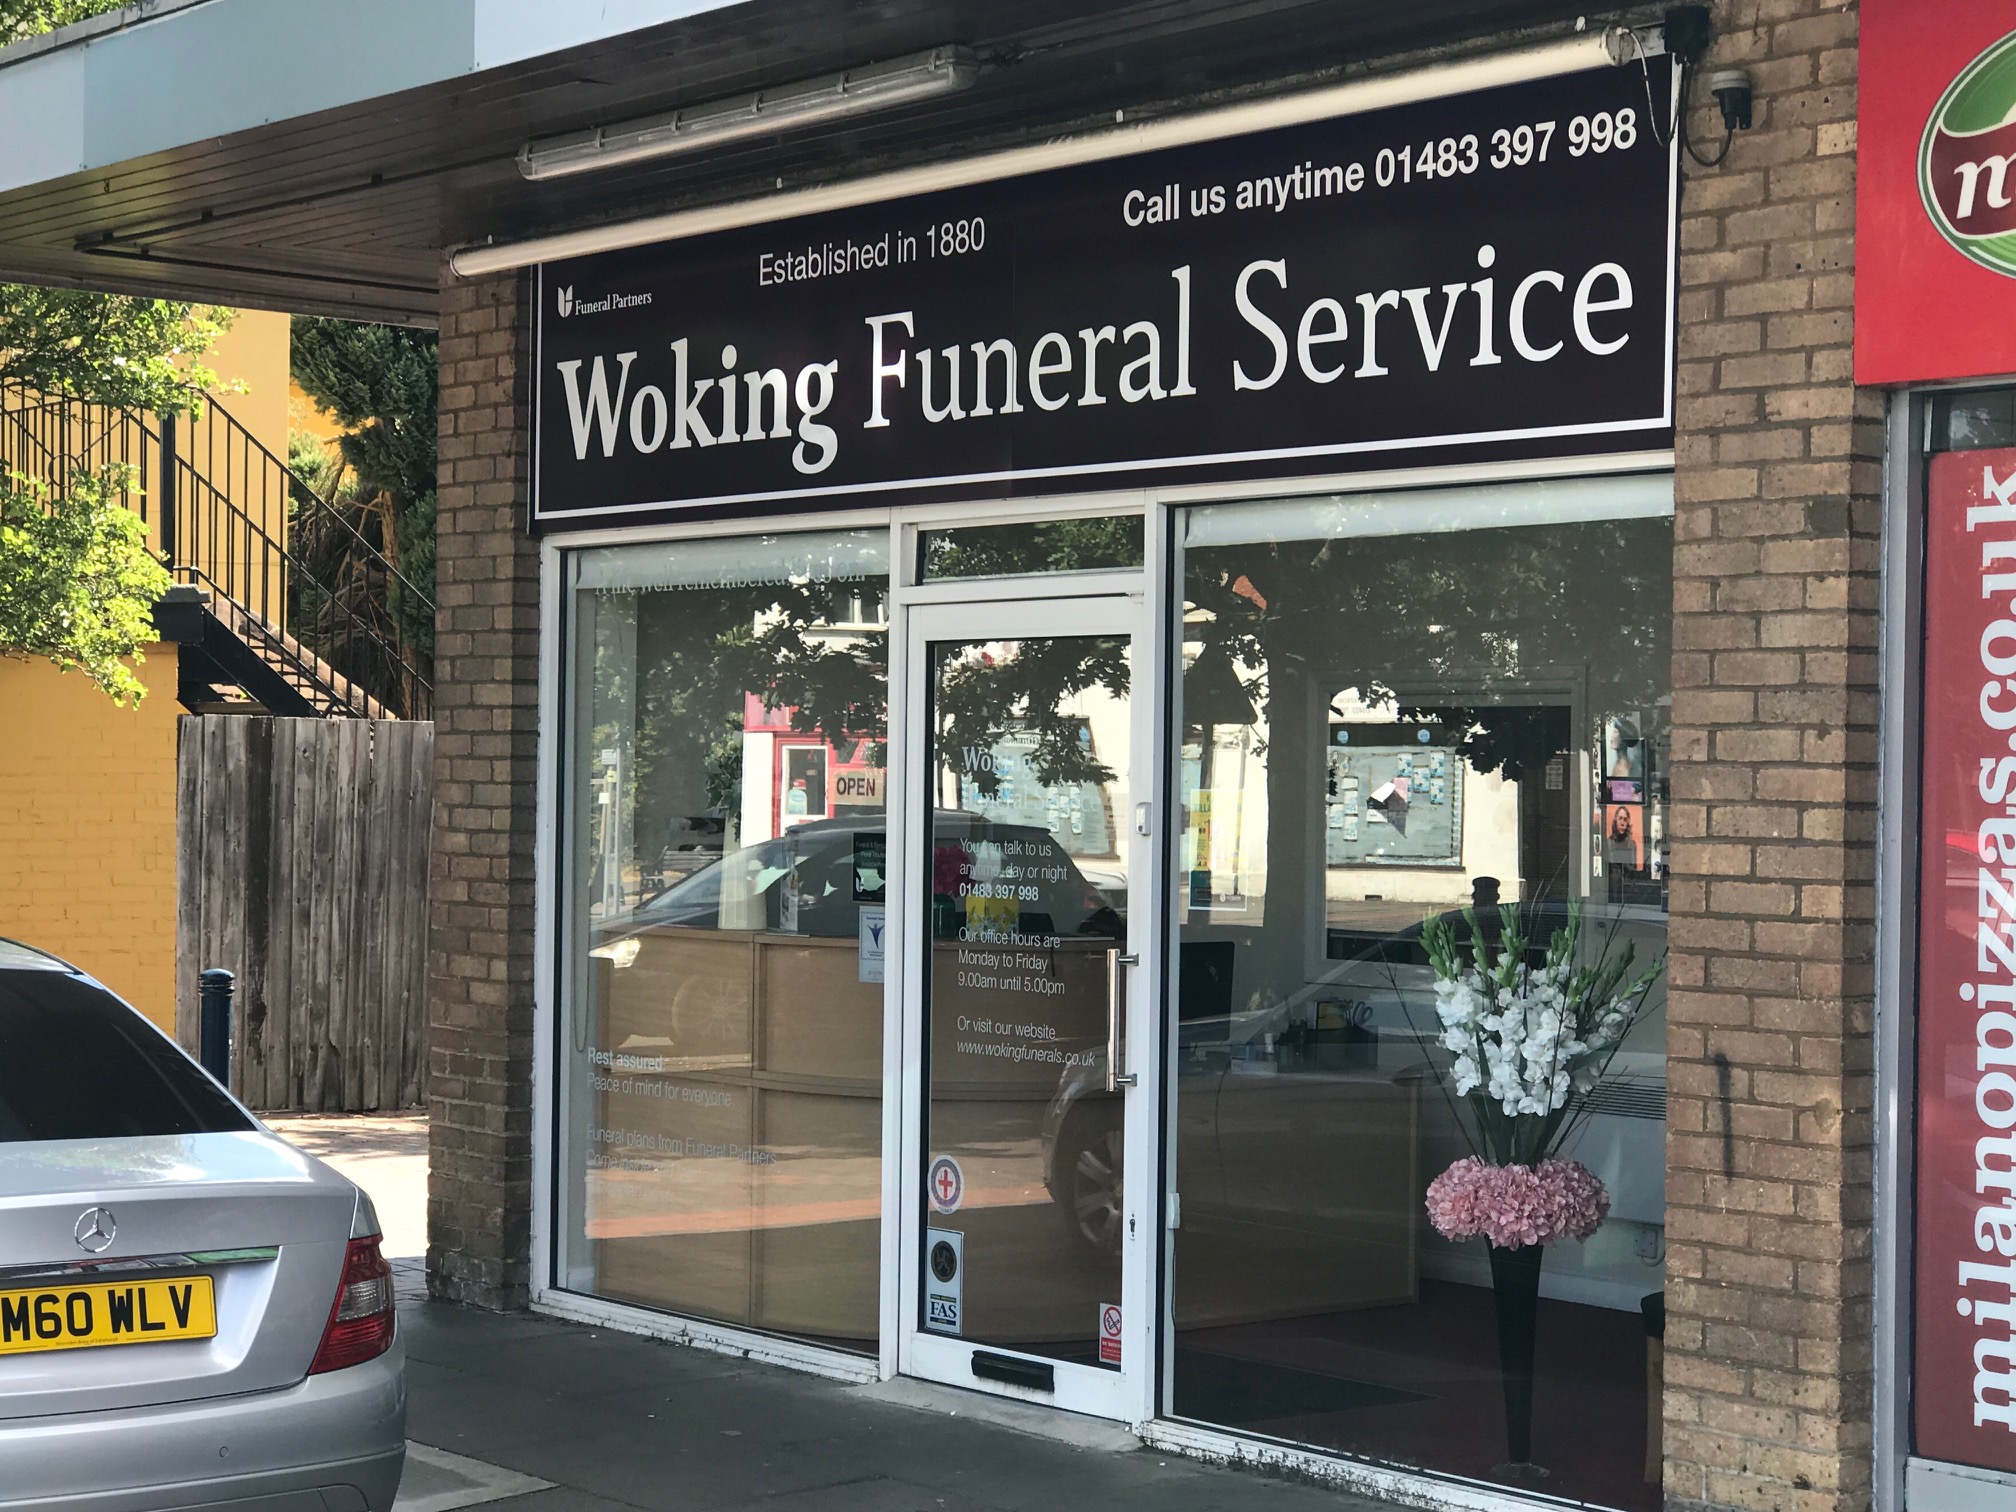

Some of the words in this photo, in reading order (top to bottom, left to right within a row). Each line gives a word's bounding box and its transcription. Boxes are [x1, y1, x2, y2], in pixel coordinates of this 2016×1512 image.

[1123, 184, 1179, 227] Call
[1190, 183, 1226, 217] us
[1236, 162, 1364, 214] anytime
[1375, 134, 1478, 187] 01483
[1490, 121, 1556, 169] 397
[1568, 108, 1637, 158] 998
[759, 233, 889, 286] Established
[897, 230, 917, 263] in
[927, 217, 986, 259] 1880
[575, 295, 611, 315] Funeral
[612, 290, 652, 311] Partners
[557, 337, 838, 474] Woking
[863, 264, 1197, 430] Funeral
[1233, 244, 1634, 392] Service
[836, 777, 876, 796] OPEN
[960, 838, 979, 854] You
[1004, 840, 1023, 856] talk
[1025, 842, 1037, 856] to
[1038, 844, 1052, 857] us
[1005, 862, 1025, 882] day
[1027, 866, 1039, 879] or
[1041, 864, 1068, 884] night
[959, 882, 992, 899] 01483
[995, 884, 1016, 900] 397
[1018, 885, 1039, 902] 998
[958, 926, 978, 944] Our
[980, 928, 1008, 945] office
[1010, 931, 1041, 948] hours
[1043, 934, 1061, 949] are
[958, 949, 1000, 970] Monday
[1002, 953, 1014, 968] to
[1016, 953, 1048, 974] Friday
[957, 972, 997, 990] 9.00am
[1000, 975, 1021, 992] until
[1024, 977, 1065, 998] 5.00pm
[957, 1016, 970, 1032] Or
[972, 1018, 992, 1035] visit
[995, 1021, 1012, 1036] our
[1015, 1023, 1056, 1040] website
[587, 1047, 613, 1065] Rest
[957, 1041, 1096, 1067] www.wokingfunerals.co.uk
[586, 1072, 620, 1092] Peace
[622, 1077, 633, 1094] of
[635, 1080, 662, 1098] mind
[664, 1082, 679, 1100] for
[682, 1088, 735, 1108] everyone.
[586, 1122, 624, 1144] Funeral
[626, 1130, 655, 1149] plans
[658, 1134, 683, 1154] from
[685, 1136, 727, 1159] Funeral
[729, 1143, 777, 1168] Partners
[586, 1149, 618, 1169] Come
[1, 1292, 94, 1343] M60
[107, 1284, 193, 1335] WLV
[930, 1301, 957, 1319] FAS
